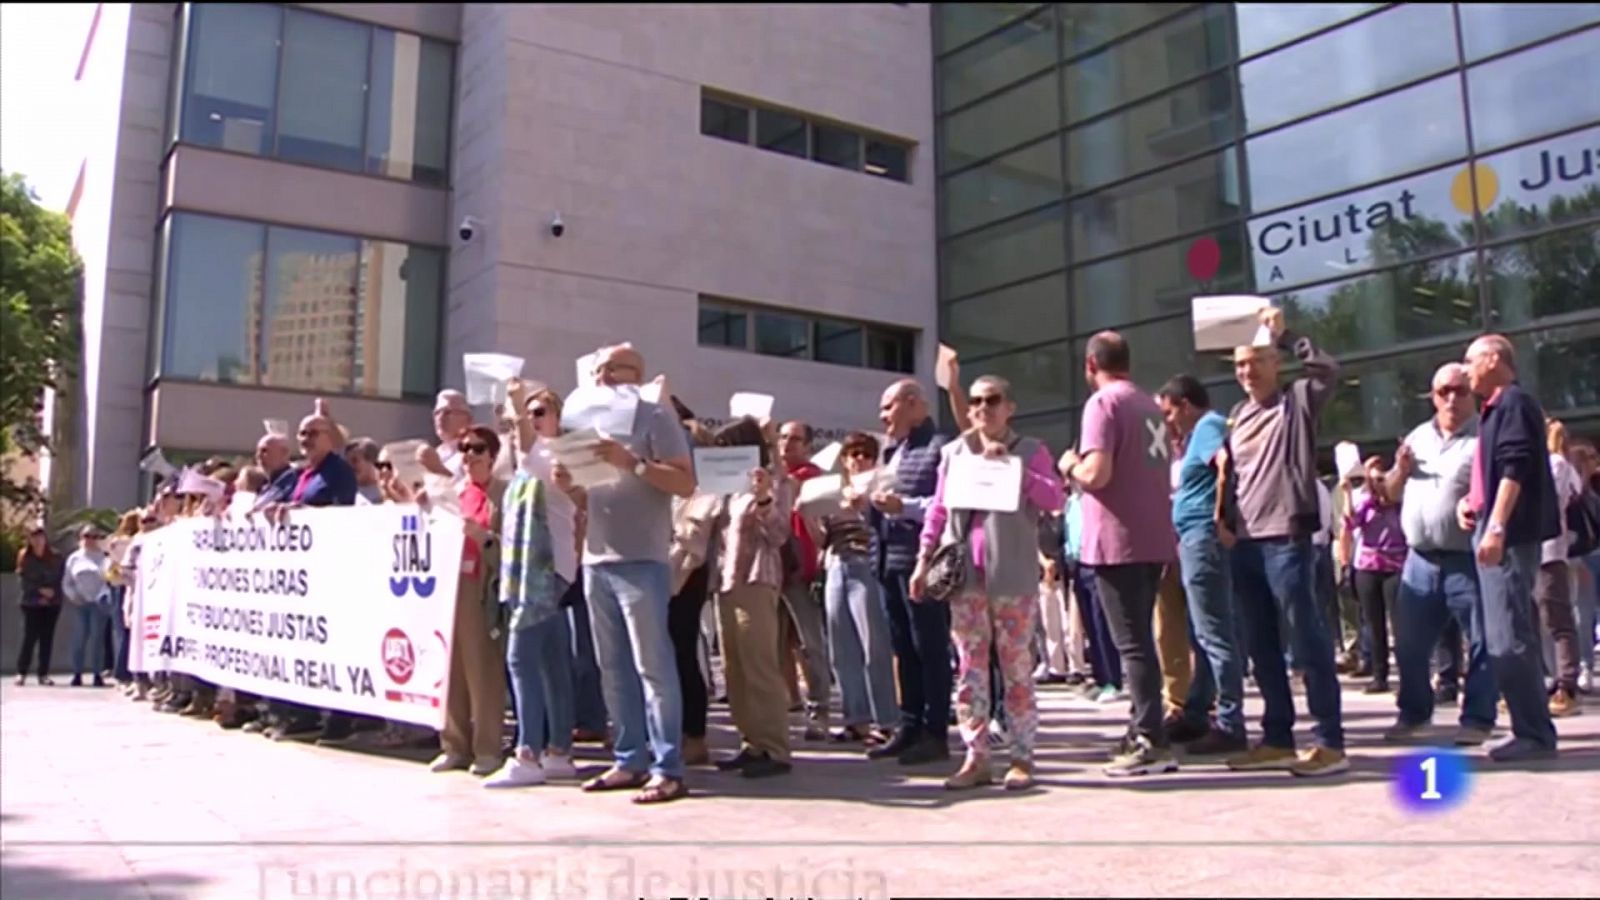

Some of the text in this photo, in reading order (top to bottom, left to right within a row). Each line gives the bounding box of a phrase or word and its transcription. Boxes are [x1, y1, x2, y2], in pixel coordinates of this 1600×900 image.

[1258, 189, 1416, 257] Ciutat
[392, 531, 432, 574] STAJ
[253, 567, 308, 597] CLARAS
[267, 612, 328, 645] JUSTAS
[294, 657, 343, 693] REAL
[346, 664, 376, 698] YA
